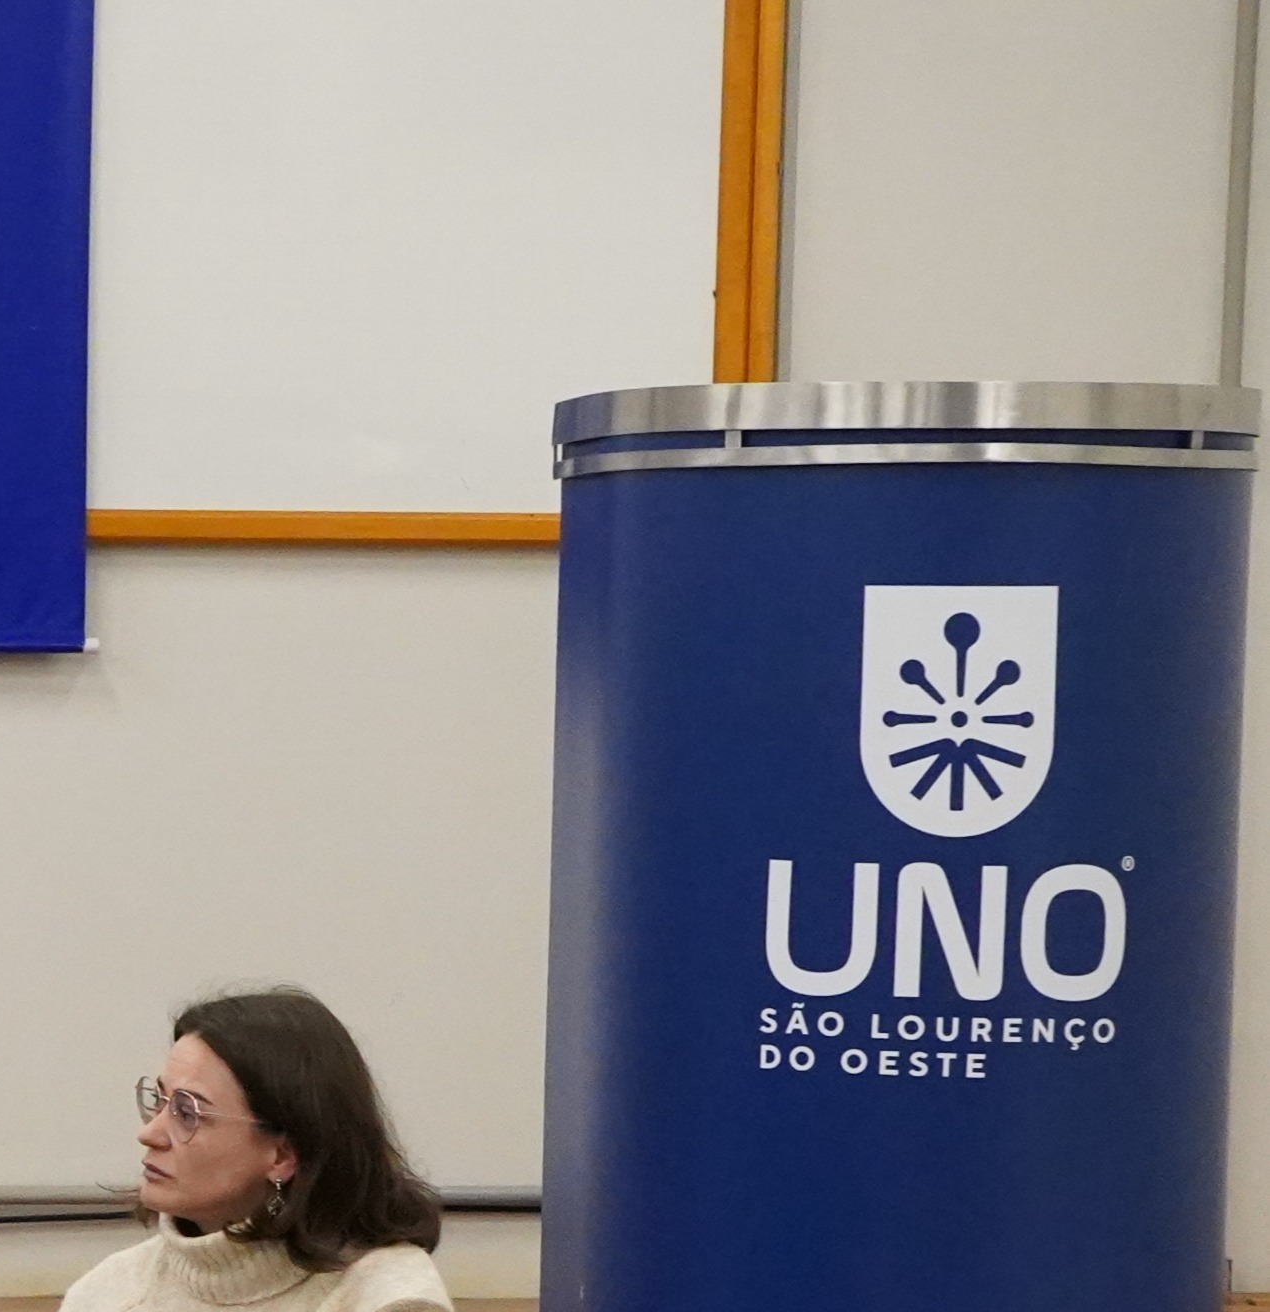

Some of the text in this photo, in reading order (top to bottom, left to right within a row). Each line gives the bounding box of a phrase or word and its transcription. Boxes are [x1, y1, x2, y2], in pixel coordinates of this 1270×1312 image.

[766, 859, 1127, 1001] UNO
[759, 1002, 1115, 1050] SÃO LOURENÇO
[759, 1045, 986, 1078] DO OESTE
